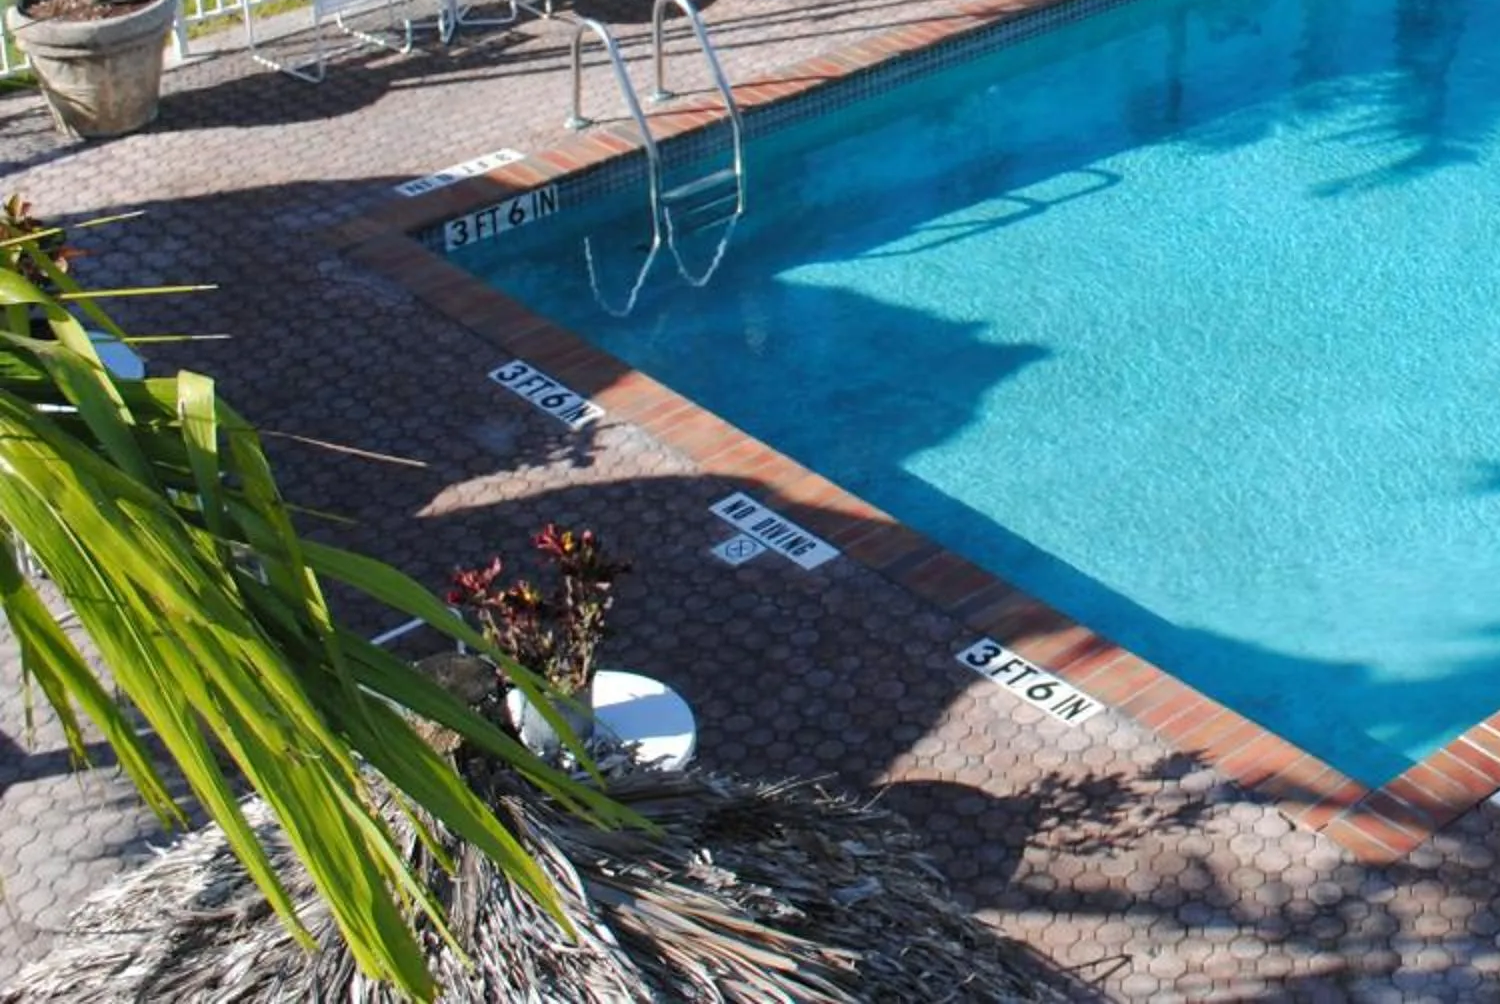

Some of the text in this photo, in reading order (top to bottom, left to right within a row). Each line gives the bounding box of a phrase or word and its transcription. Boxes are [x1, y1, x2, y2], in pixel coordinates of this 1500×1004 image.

[451, 187, 556, 246] 3 FT 6 IN
[496, 365, 591, 422] 3 FT 6 IN
[721, 499, 817, 556] NO DIVING
[966, 645, 1094, 720] 3 FT 6 IN
